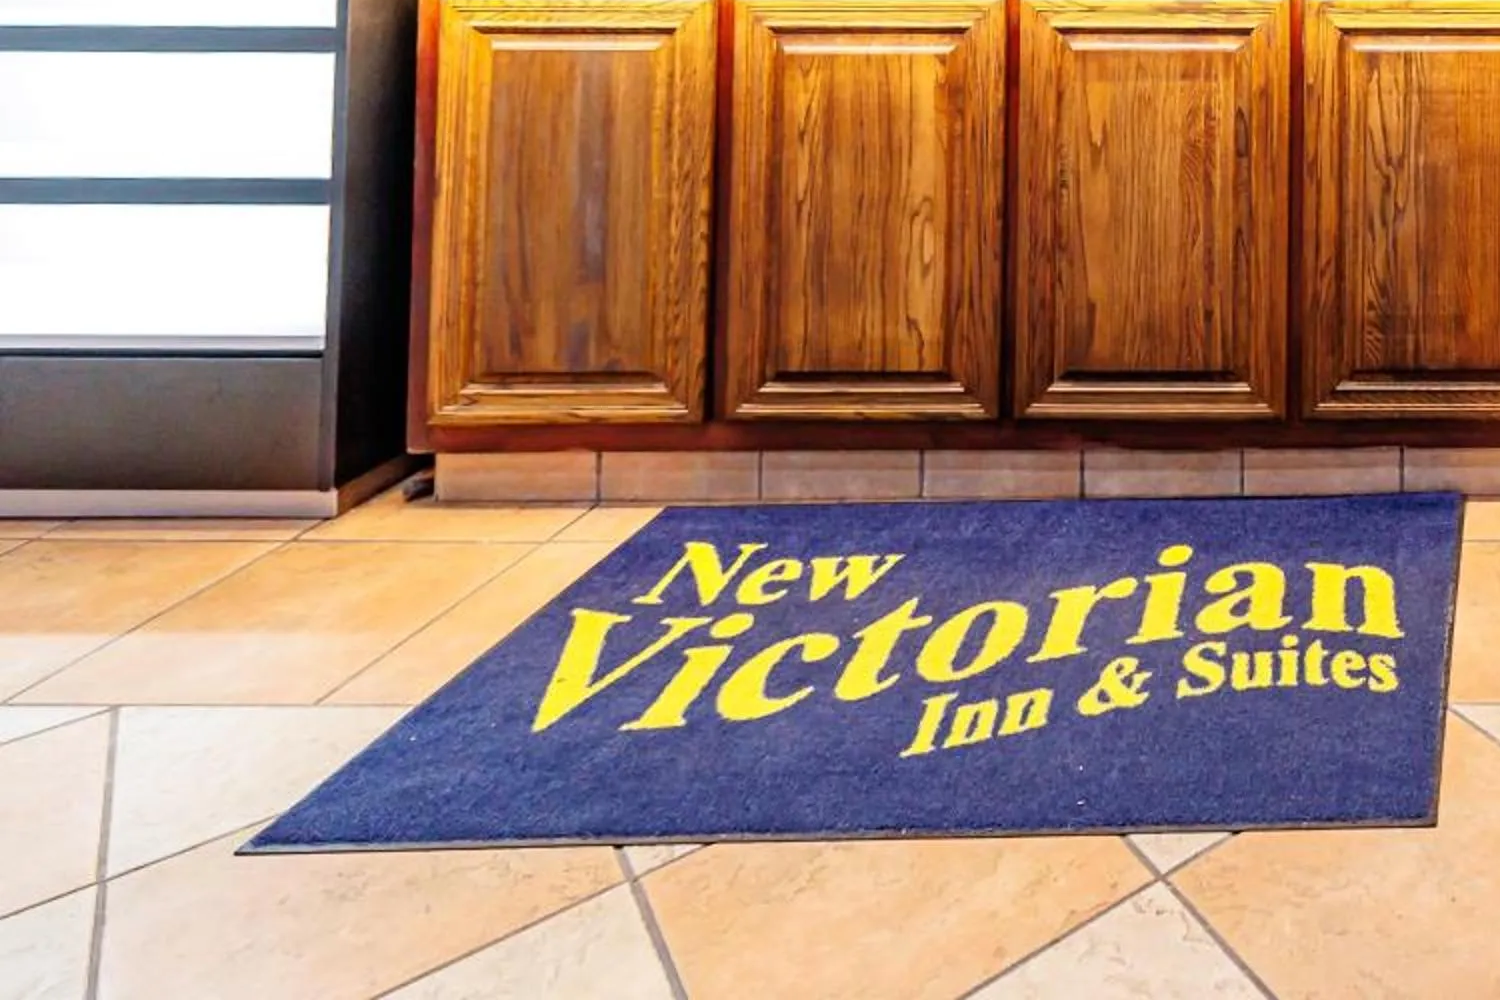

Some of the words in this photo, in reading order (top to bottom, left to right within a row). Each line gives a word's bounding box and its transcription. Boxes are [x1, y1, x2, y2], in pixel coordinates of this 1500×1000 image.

[634, 541, 905, 606] New
[532, 544, 1406, 734] Victorian
[899, 687, 1056, 759] Inn
[1077, 657, 1155, 718] &
[1176, 635, 1401, 699] Suites
